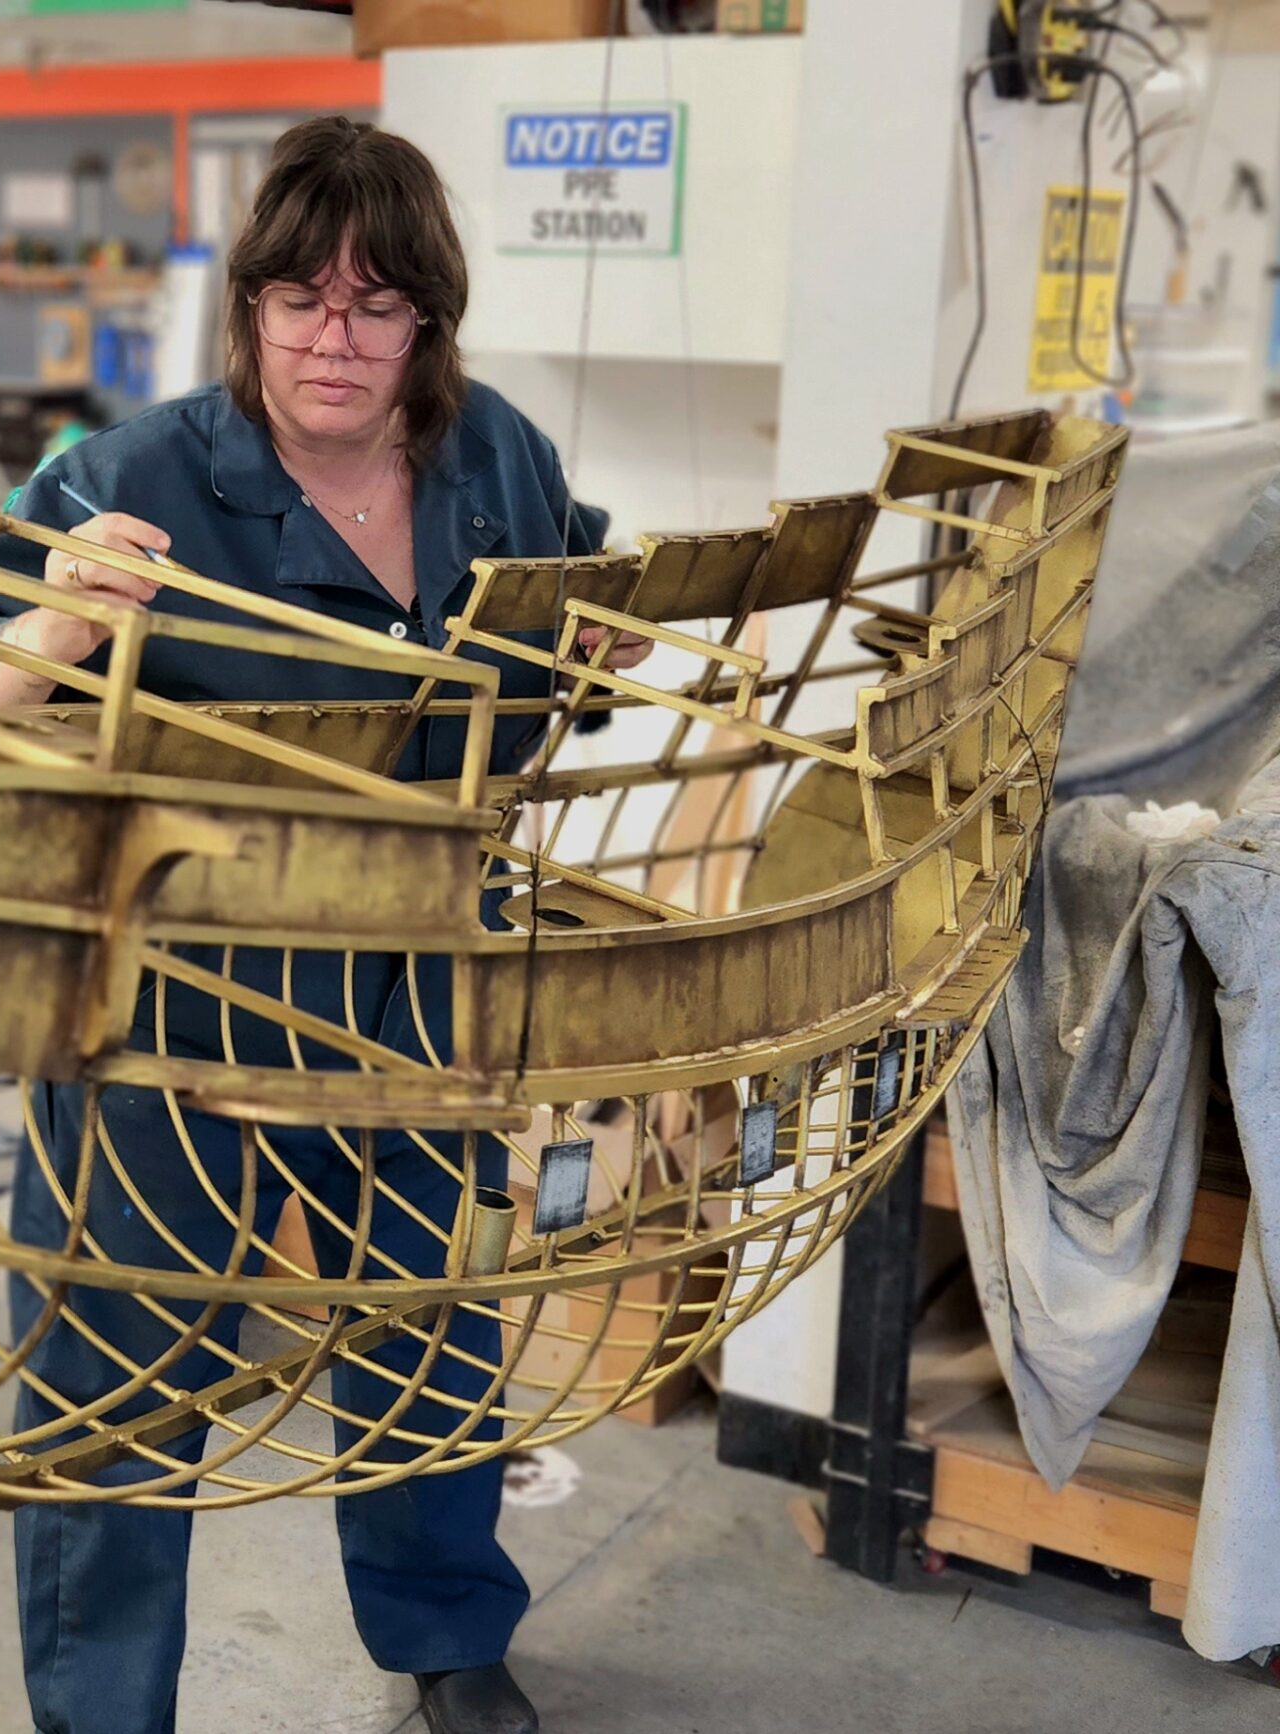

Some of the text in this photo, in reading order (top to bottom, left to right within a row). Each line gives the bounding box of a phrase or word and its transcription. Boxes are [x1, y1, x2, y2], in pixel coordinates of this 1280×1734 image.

[511, 119, 667, 161] NOTICE
[562, 169, 619, 201] PPE
[530, 209, 647, 241] STATION
